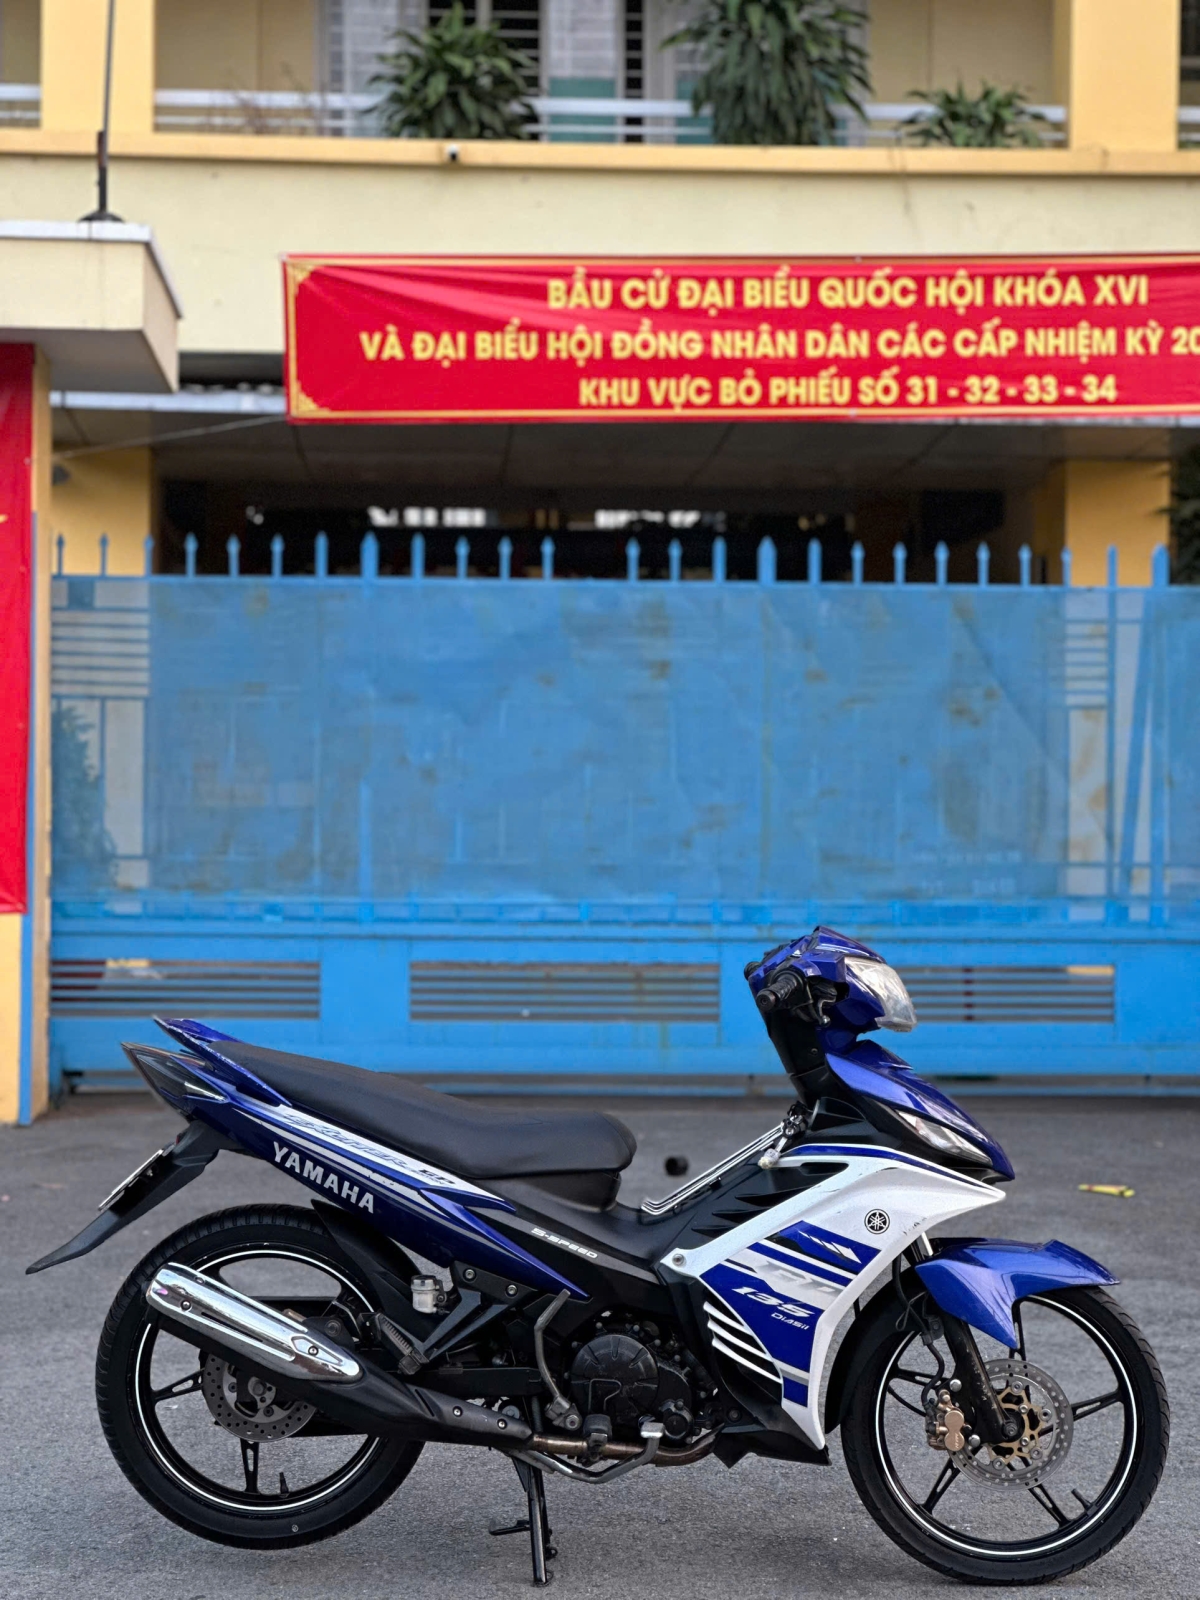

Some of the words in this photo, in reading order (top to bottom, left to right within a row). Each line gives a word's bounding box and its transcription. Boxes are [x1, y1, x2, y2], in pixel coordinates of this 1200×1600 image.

[621, 268, 670, 309] CỬ
[677, 279, 734, 316] ĐẠI
[743, 264, 810, 308] BIỂU
[818, 267, 917, 308] QUỐC
[926, 269, 984, 315] HỘI
[993, 268, 1085, 306] KHÓA
[1094, 275, 1148, 305] XVI
[360, 324, 404, 360] VÀ
[412, 332, 466, 368] ĐẠI
[475, 317, 538, 360] BIỂU
[547, 324, 603, 367] HỘI
[711, 323, 797, 358] NHÂN
[805, 323, 870, 358] DÂN
[877, 322, 946, 358] CÁC
[953, 317, 1018, 357] CẤP
[1025, 321, 1117, 363] NHIỆM
[1125, 319, 1164, 356] KỲ
[579, 377, 640, 406] KHU
[647, 374, 711, 412] VỰC
[719, 367, 762, 405] BỎ
[769, 366, 851, 405] PHIẾU
[858, 366, 900, 405] SỐ
[906, 375, 938, 404] 31
[948, 388, 959, 397] -
[965, 375, 1000, 404] 32
[1006, 387, 1017, 396] -
[1024, 375, 1059, 403] 33
[1065, 386, 1076, 396] -
[1082, 374, 1118, 402] 34
[273, 1141, 375, 1214] YAMAHA
[731, 1286, 815, 1318] 135
